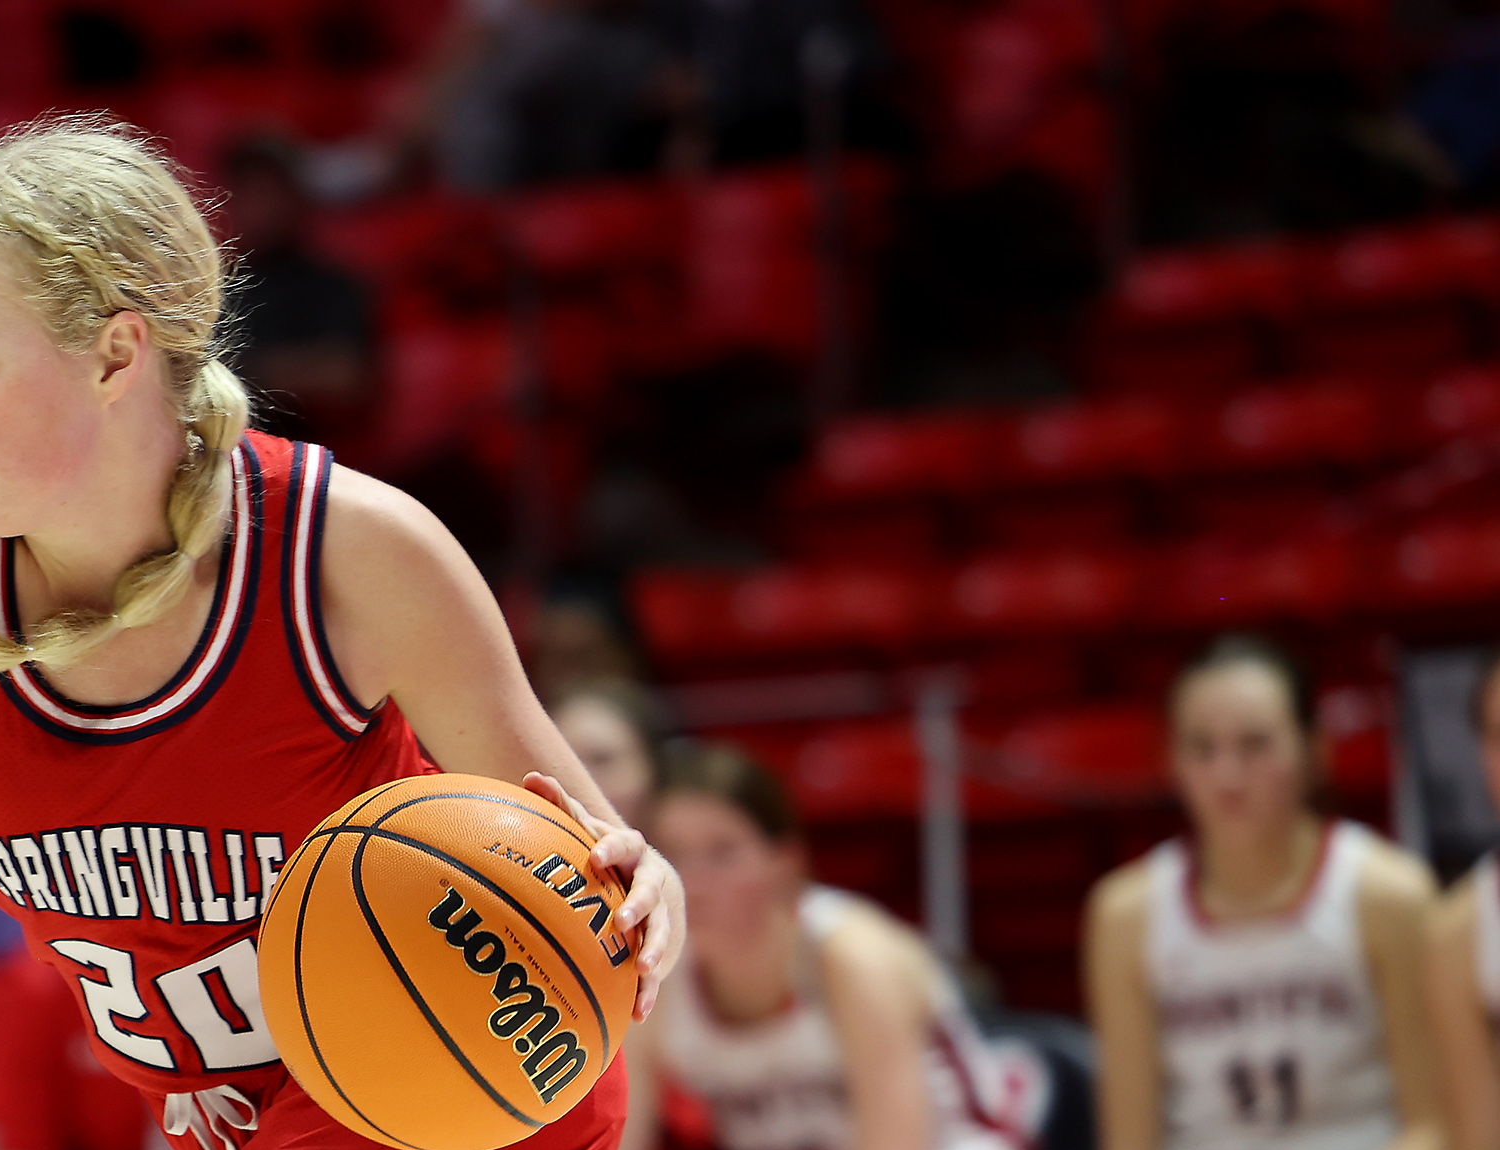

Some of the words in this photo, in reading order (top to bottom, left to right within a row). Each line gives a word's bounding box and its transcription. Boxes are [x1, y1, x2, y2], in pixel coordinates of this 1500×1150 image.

[484, 842, 533, 869] NXT
[505, 925, 525, 953] BALL
[531, 853, 631, 969] EVO
[46, 934, 282, 1073] 20
[427, 885, 588, 1107] Wilson
[527, 954, 550, 983] GAME
